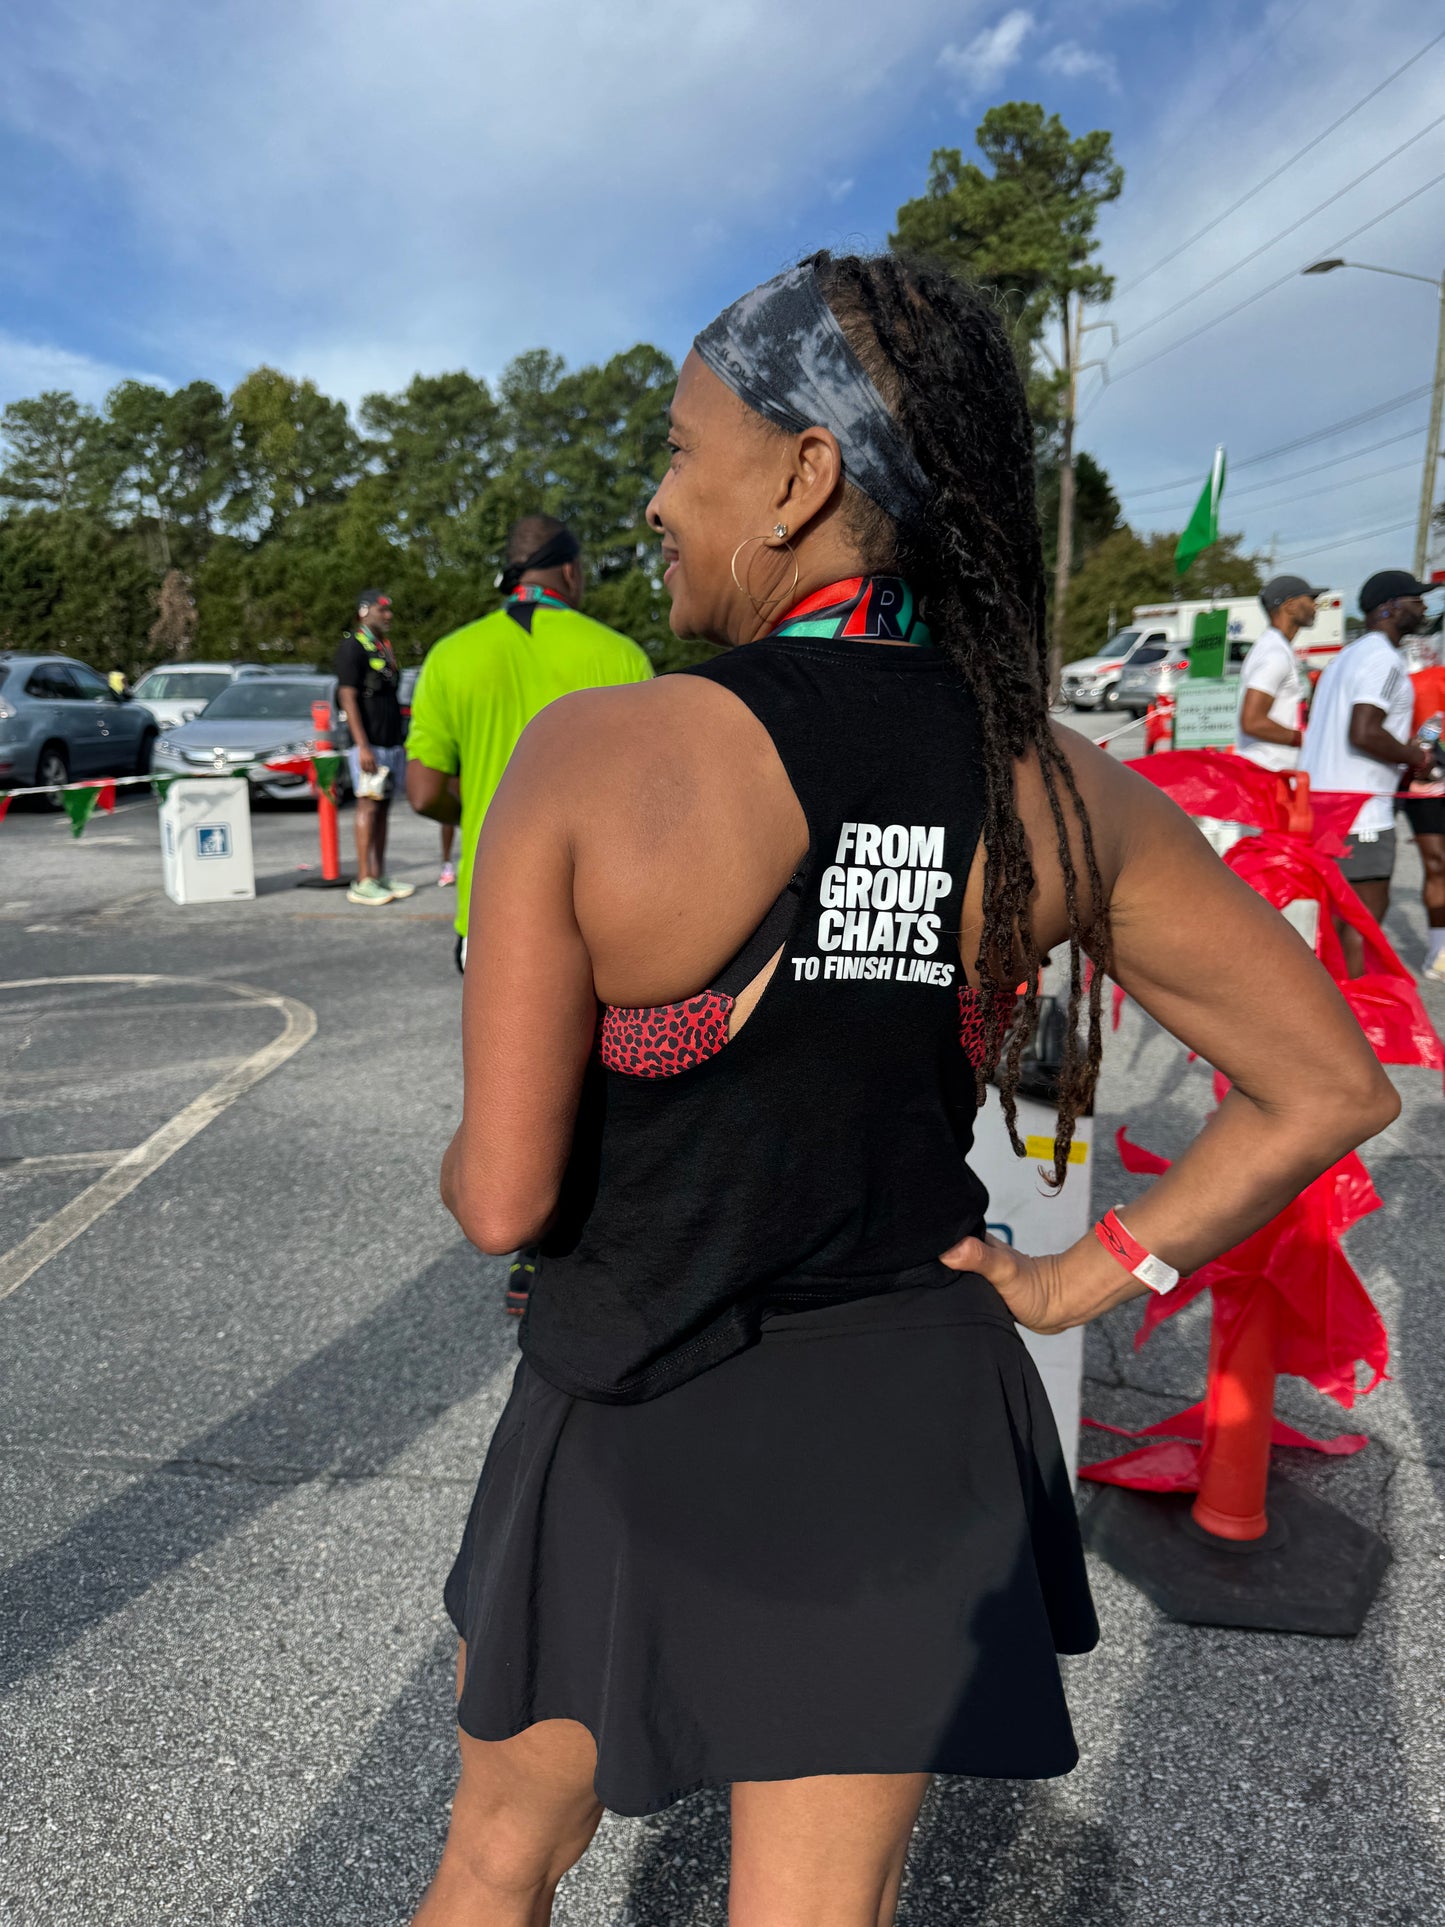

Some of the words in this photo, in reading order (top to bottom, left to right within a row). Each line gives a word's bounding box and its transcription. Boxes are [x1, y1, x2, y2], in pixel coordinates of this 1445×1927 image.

[835, 822, 945, 868] FROM
[819, 865, 953, 912] GROUP
[817, 909, 942, 955] CHATS
[792, 957, 820, 981] TO
[823, 955, 894, 980] FINISH
[895, 957, 956, 987] LINES
